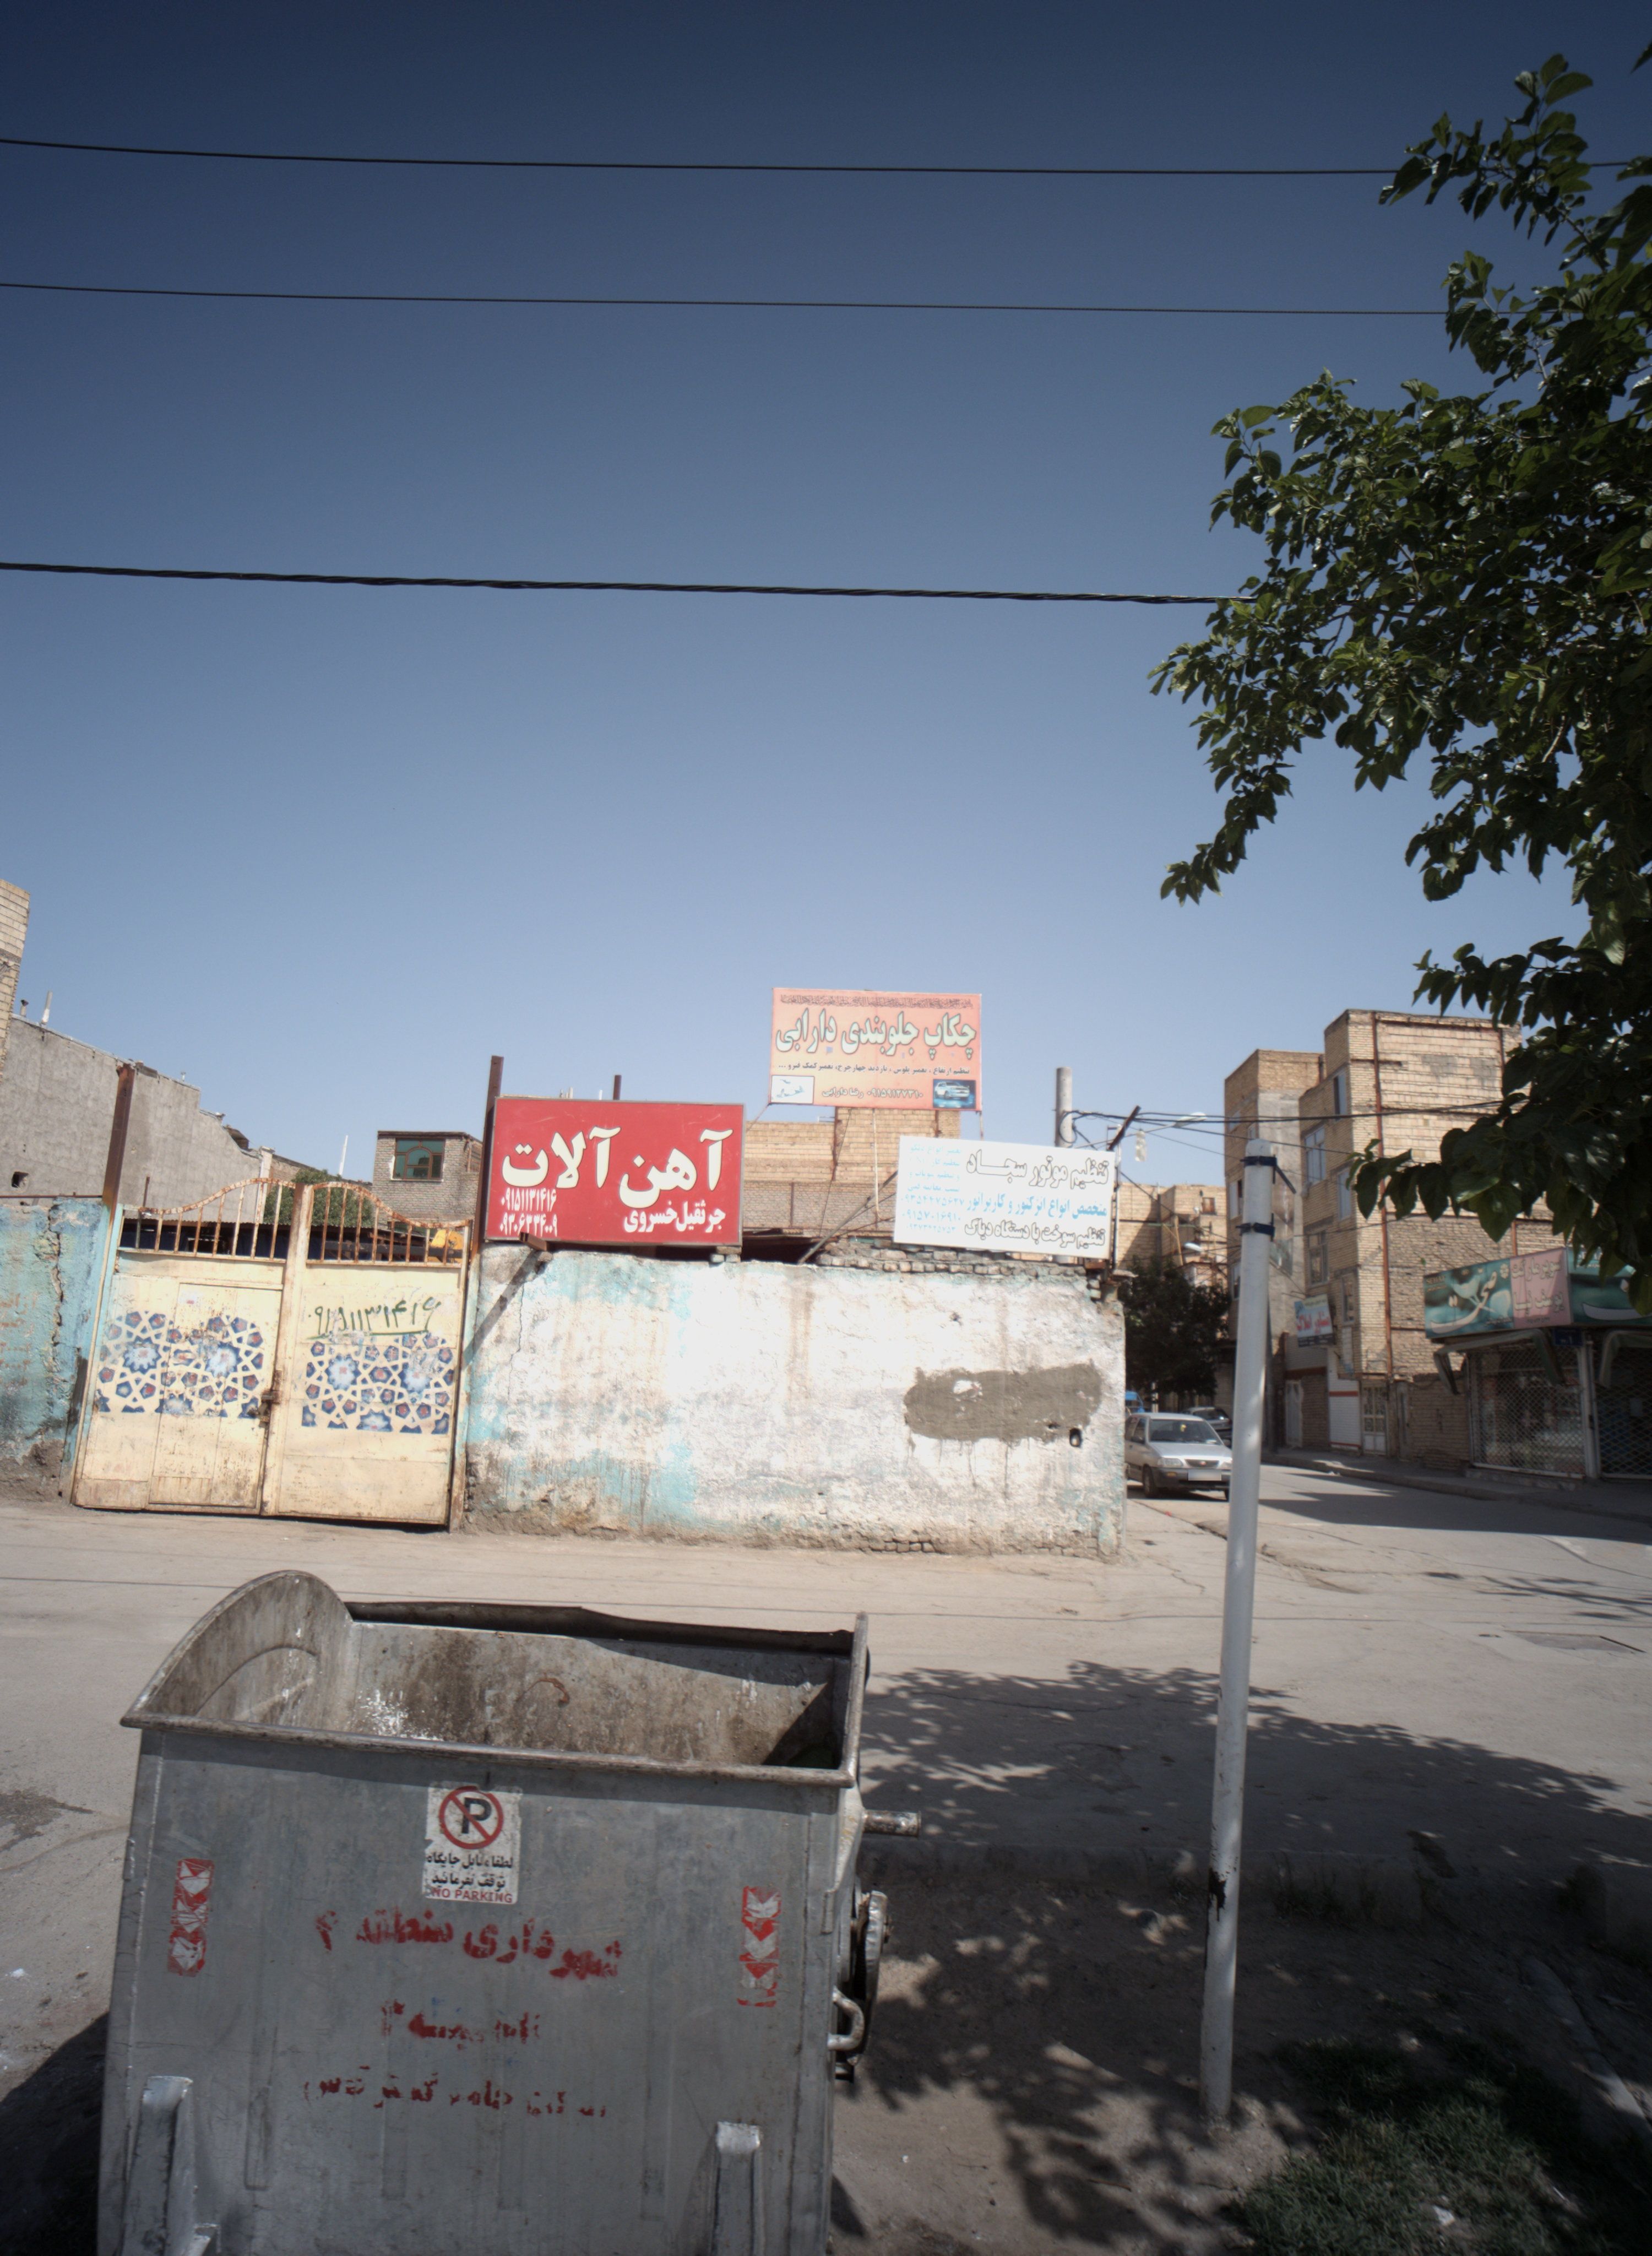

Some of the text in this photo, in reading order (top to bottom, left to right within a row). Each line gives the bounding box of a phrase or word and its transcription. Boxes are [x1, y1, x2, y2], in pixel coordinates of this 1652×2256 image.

[775, 1007, 976, 1060] چکاپ جلوبندی دارابی
[822, 1087, 849, 1098] دارابی
[849, 1087, 864, 1099] رضا
[502, 1125, 733, 1208] آهن آلات
[1029, 1155, 1068, 1189] موتور
[1070, 1157, 1109, 1190] تنظیم
[501, 1187, 557, 1212] ۰۹۱۵۱۱۳۱۴۱۶
[1048, 1197, 1070, 1218] انواع
[1072, 1200, 1107, 1219] متخصص
[623, 1200, 678, 1233] خسروی
[995, 1219, 1030, 1239] دستگاه
[1031, 1222, 1040, 1245] با
[1041, 1224, 1076, 1248] سوخت
[1077, 1227, 1106, 1249] تنظیم
[431, 1888, 513, 1903] NO PARKING
